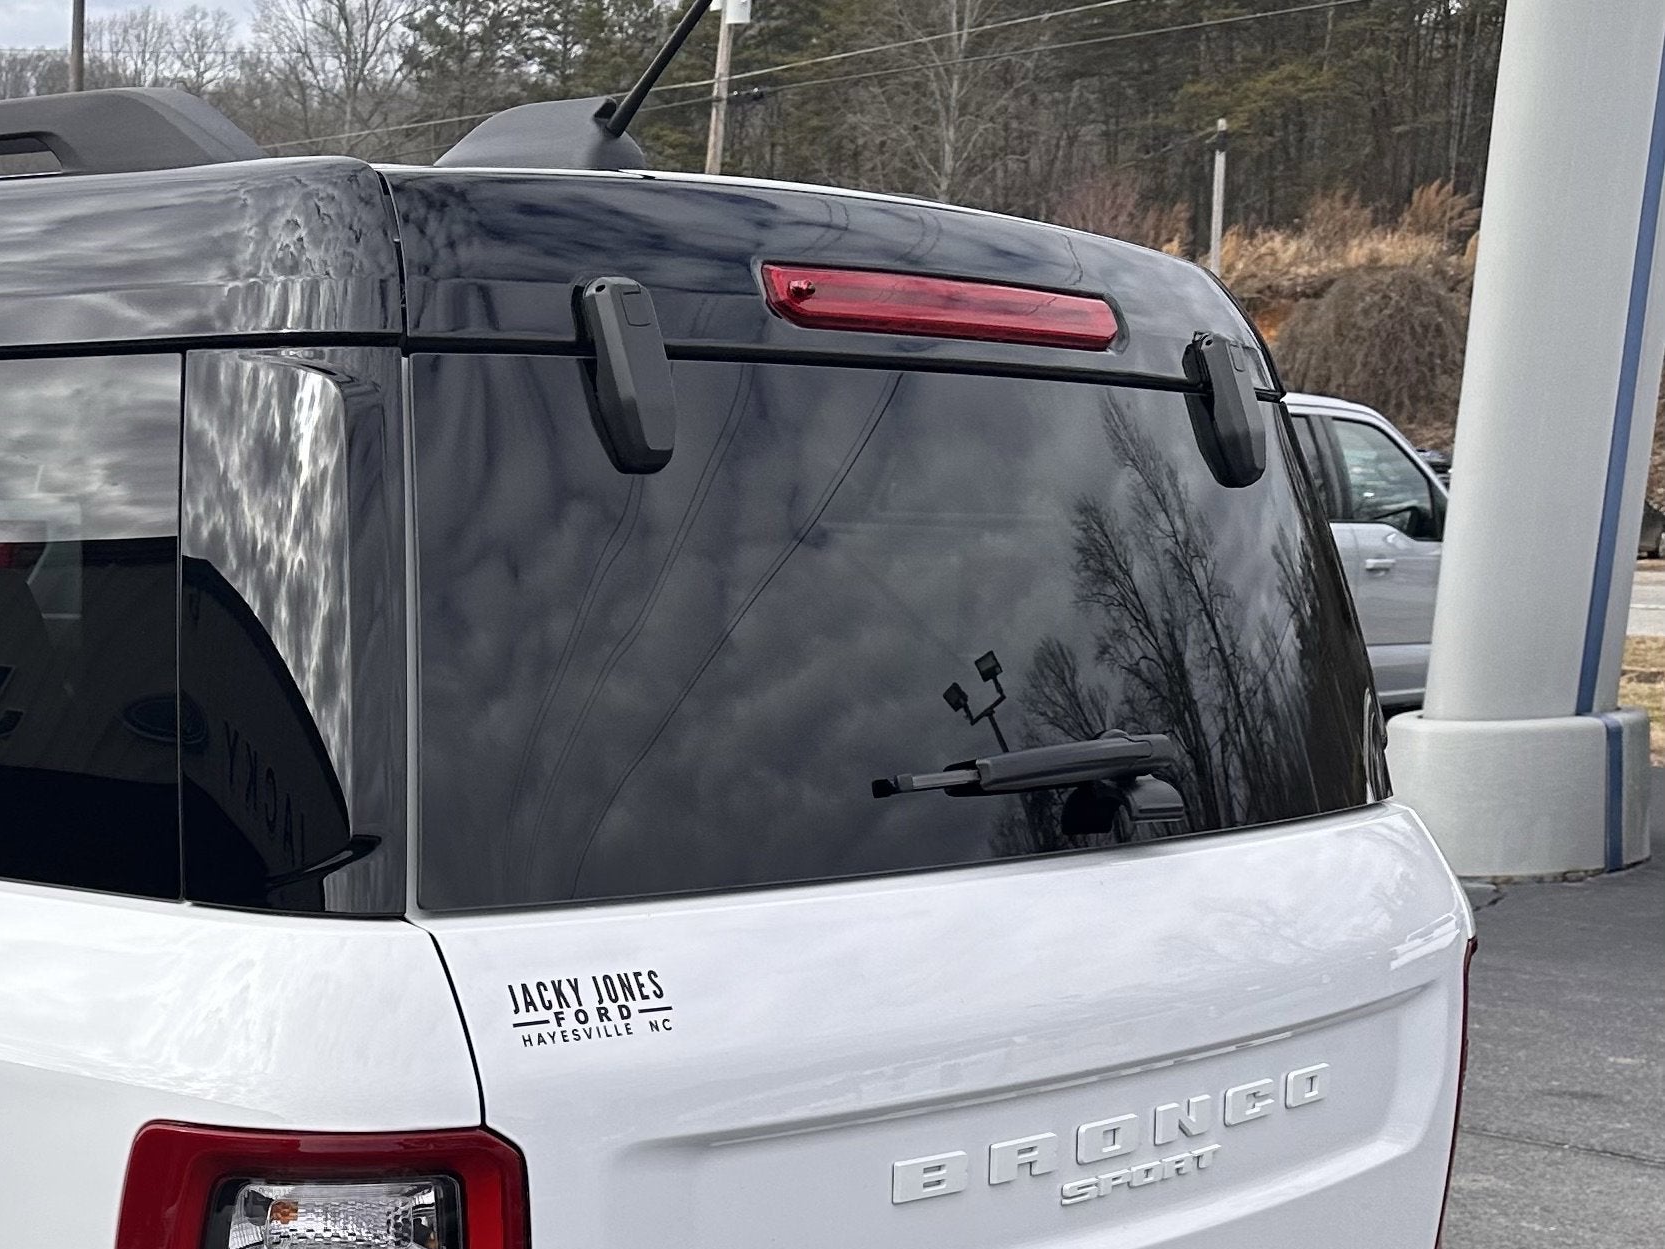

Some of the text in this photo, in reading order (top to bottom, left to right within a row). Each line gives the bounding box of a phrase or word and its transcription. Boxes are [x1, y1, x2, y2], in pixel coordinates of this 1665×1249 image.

[508, 970, 664, 1014] JACKY JONES
[522, 1018, 673, 1047] HAYESVILLE NC
[553, 1004, 632, 1027] FORD
[892, 1062, 1330, 1204] BRONCO
[1060, 1143, 1221, 1206] SPORT
